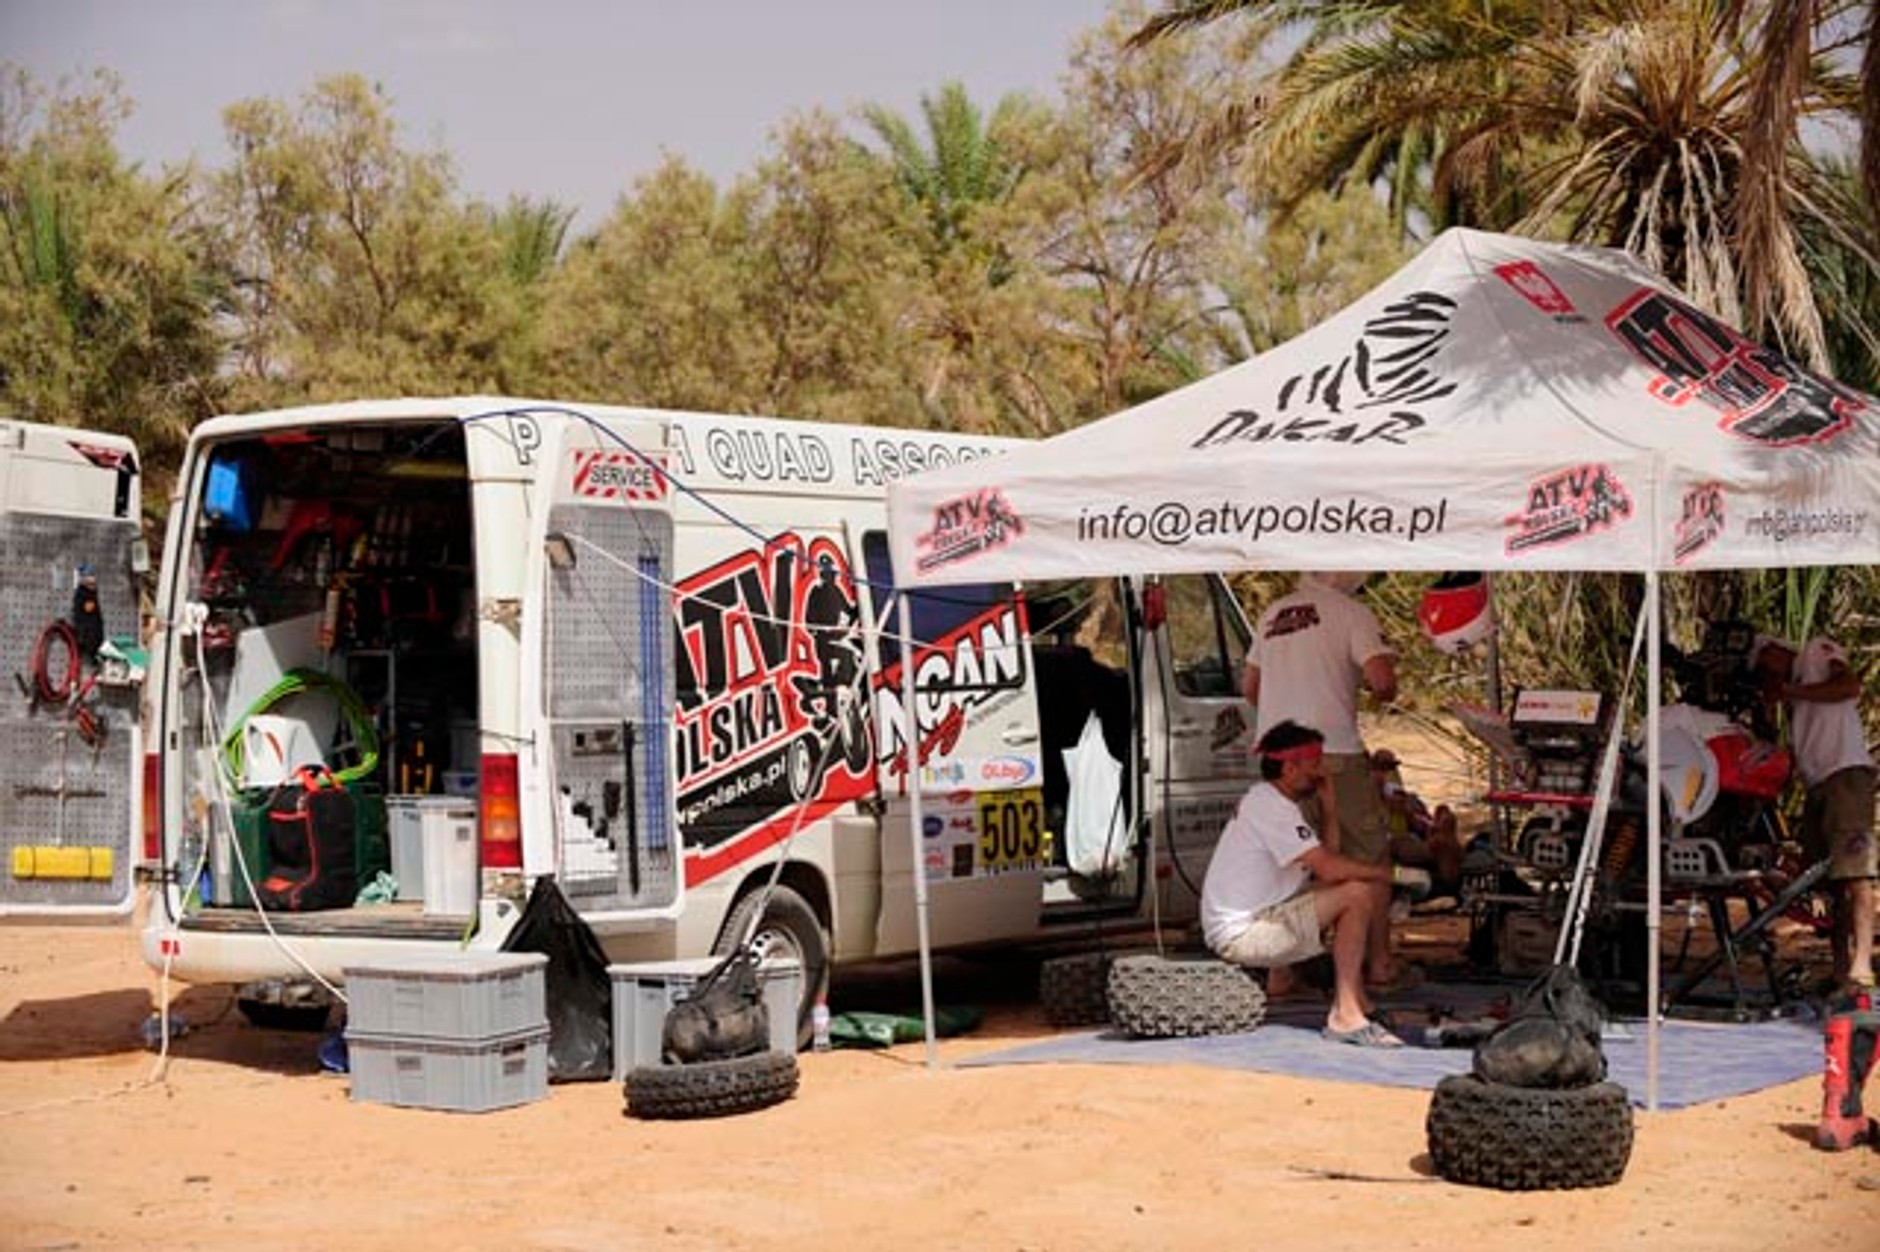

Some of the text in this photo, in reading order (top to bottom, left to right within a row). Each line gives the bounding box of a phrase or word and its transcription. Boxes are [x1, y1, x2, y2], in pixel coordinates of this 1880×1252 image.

[1192, 409, 1425, 448] DAKAR
[590, 464, 653, 487] SERVICE
[705, 428, 833, 483] QUAD
[1528, 469, 1588, 514] ATV
[935, 493, 983, 536] ATV
[1077, 498, 1447, 545] info@atvpolska.pl
[980, 799, 1039, 860] 503
